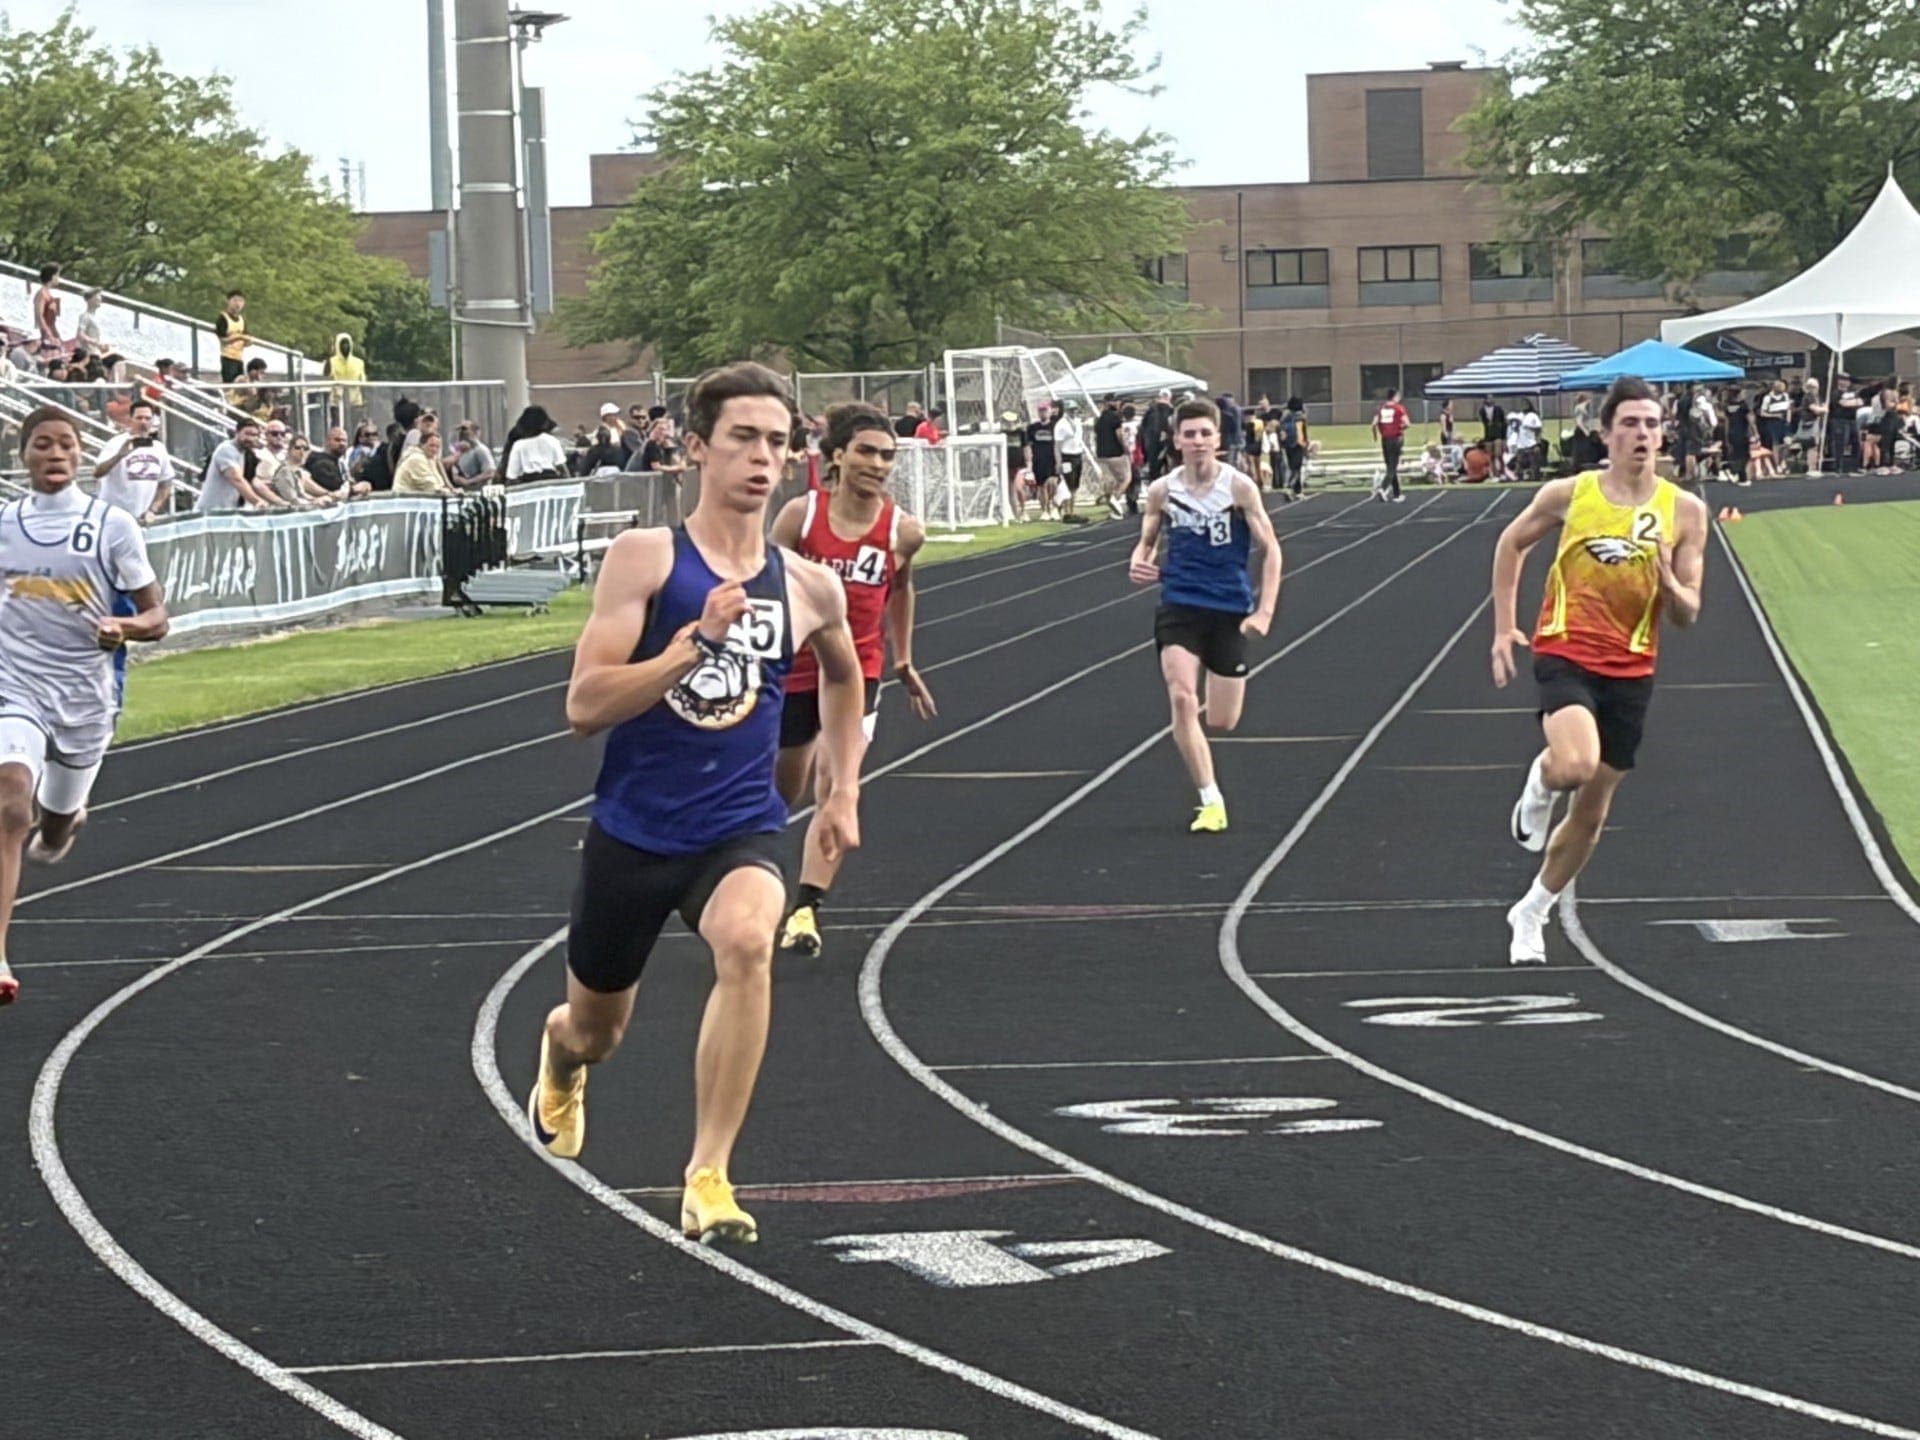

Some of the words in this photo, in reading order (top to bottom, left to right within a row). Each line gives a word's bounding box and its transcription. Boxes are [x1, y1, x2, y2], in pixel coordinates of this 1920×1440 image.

[72, 522, 95, 553] 6
[1213, 521, 1228, 543] 3
[1637, 511, 1659, 542] 2
[857, 551, 879, 581] 4
[748, 603, 776, 652] 5
[1341, 994, 1606, 1027] 2
[1050, 1097, 1384, 1137] 3
[813, 1229, 1175, 1288] 4
